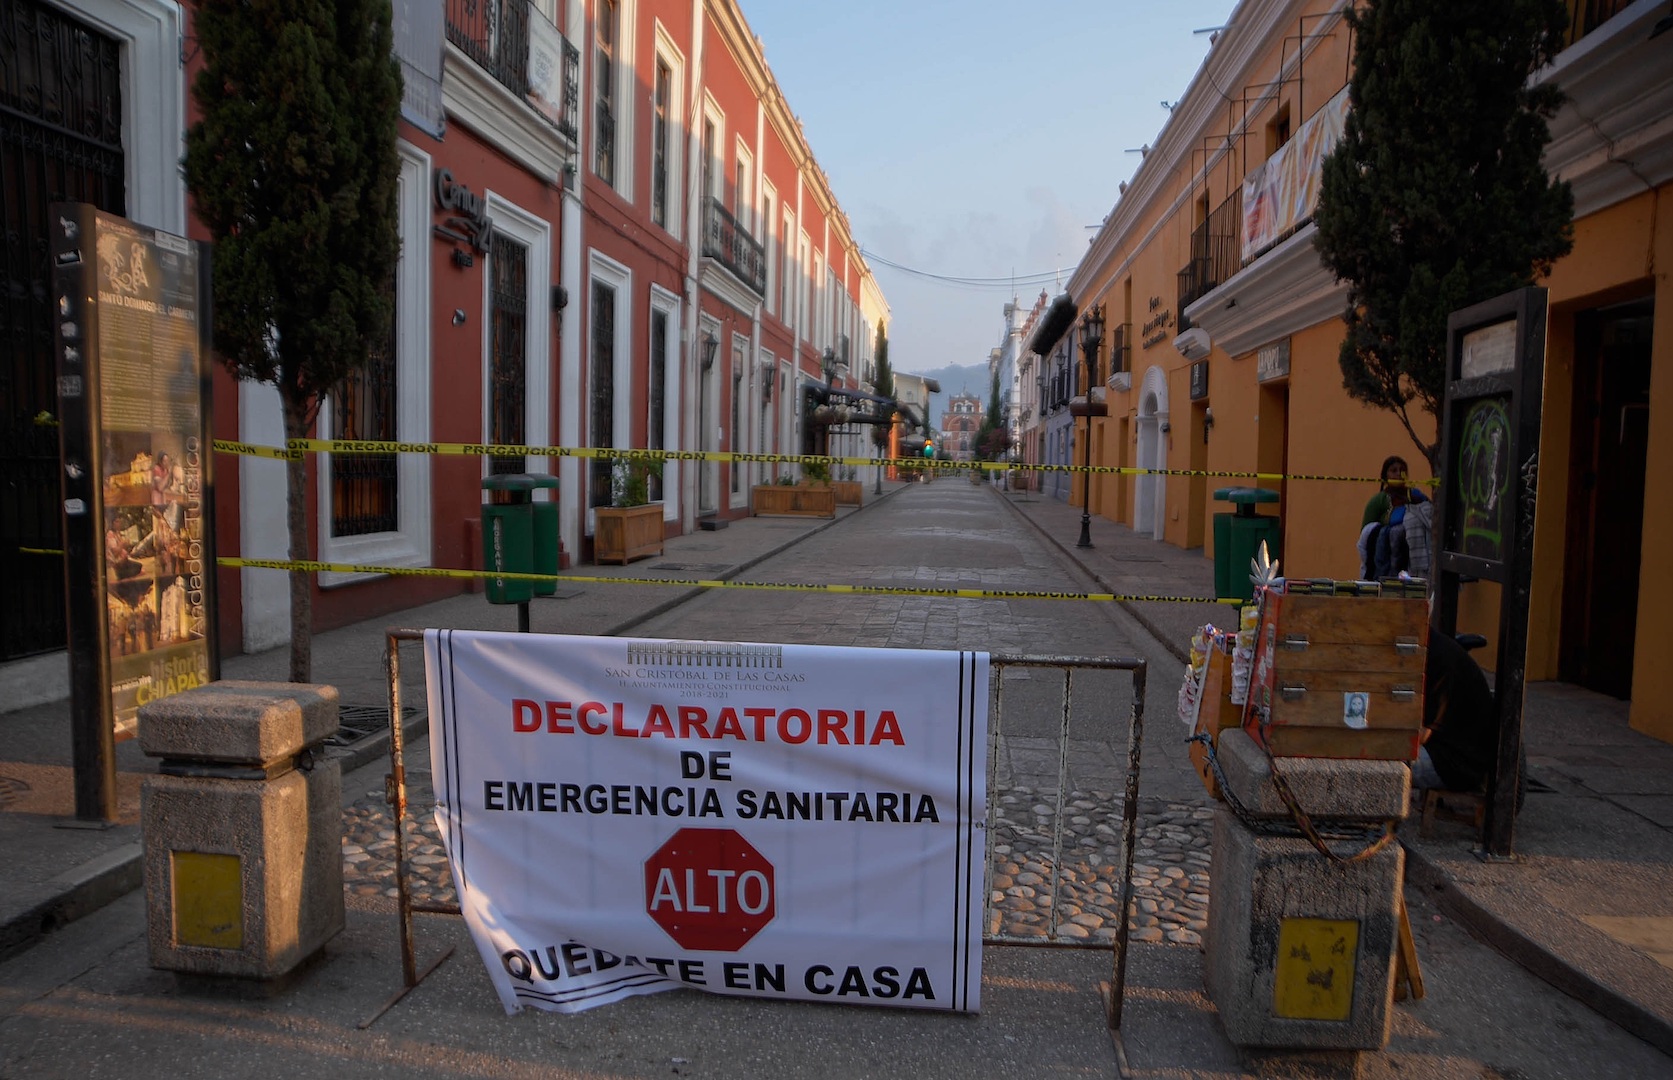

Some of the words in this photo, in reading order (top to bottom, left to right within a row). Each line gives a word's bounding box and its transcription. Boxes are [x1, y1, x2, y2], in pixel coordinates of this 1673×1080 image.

[332, 442, 439, 453] PRECAUCIÓN
[463, 445, 571, 456] PRECAUCIÓN
[187, 534, 205, 638] Andador
[136, 668, 209, 705] CHIAPAS
[604, 667, 631, 678] SAN
[635, 668, 708, 680] CRISTÓBAL
[713, 671, 731, 681] DE
[736, 670, 760, 682] LAS
[763, 671, 806, 683] CASAS
[632, 681, 705, 690] AYUNTAMIENTO
[706, 683, 790, 692] CONSTITUCIONAL
[680, 690, 729, 699] 2018-2021
[511, 697, 906, 746] DECLARATORIA
[679, 750, 732, 782] DE
[483, 780, 724, 818] EMERGENCIA
[736, 789, 940, 823] SANITARIA
[649, 867, 771, 916] ALTO
[723, 962, 786, 992] EN
[804, 964, 936, 1000] CASA
